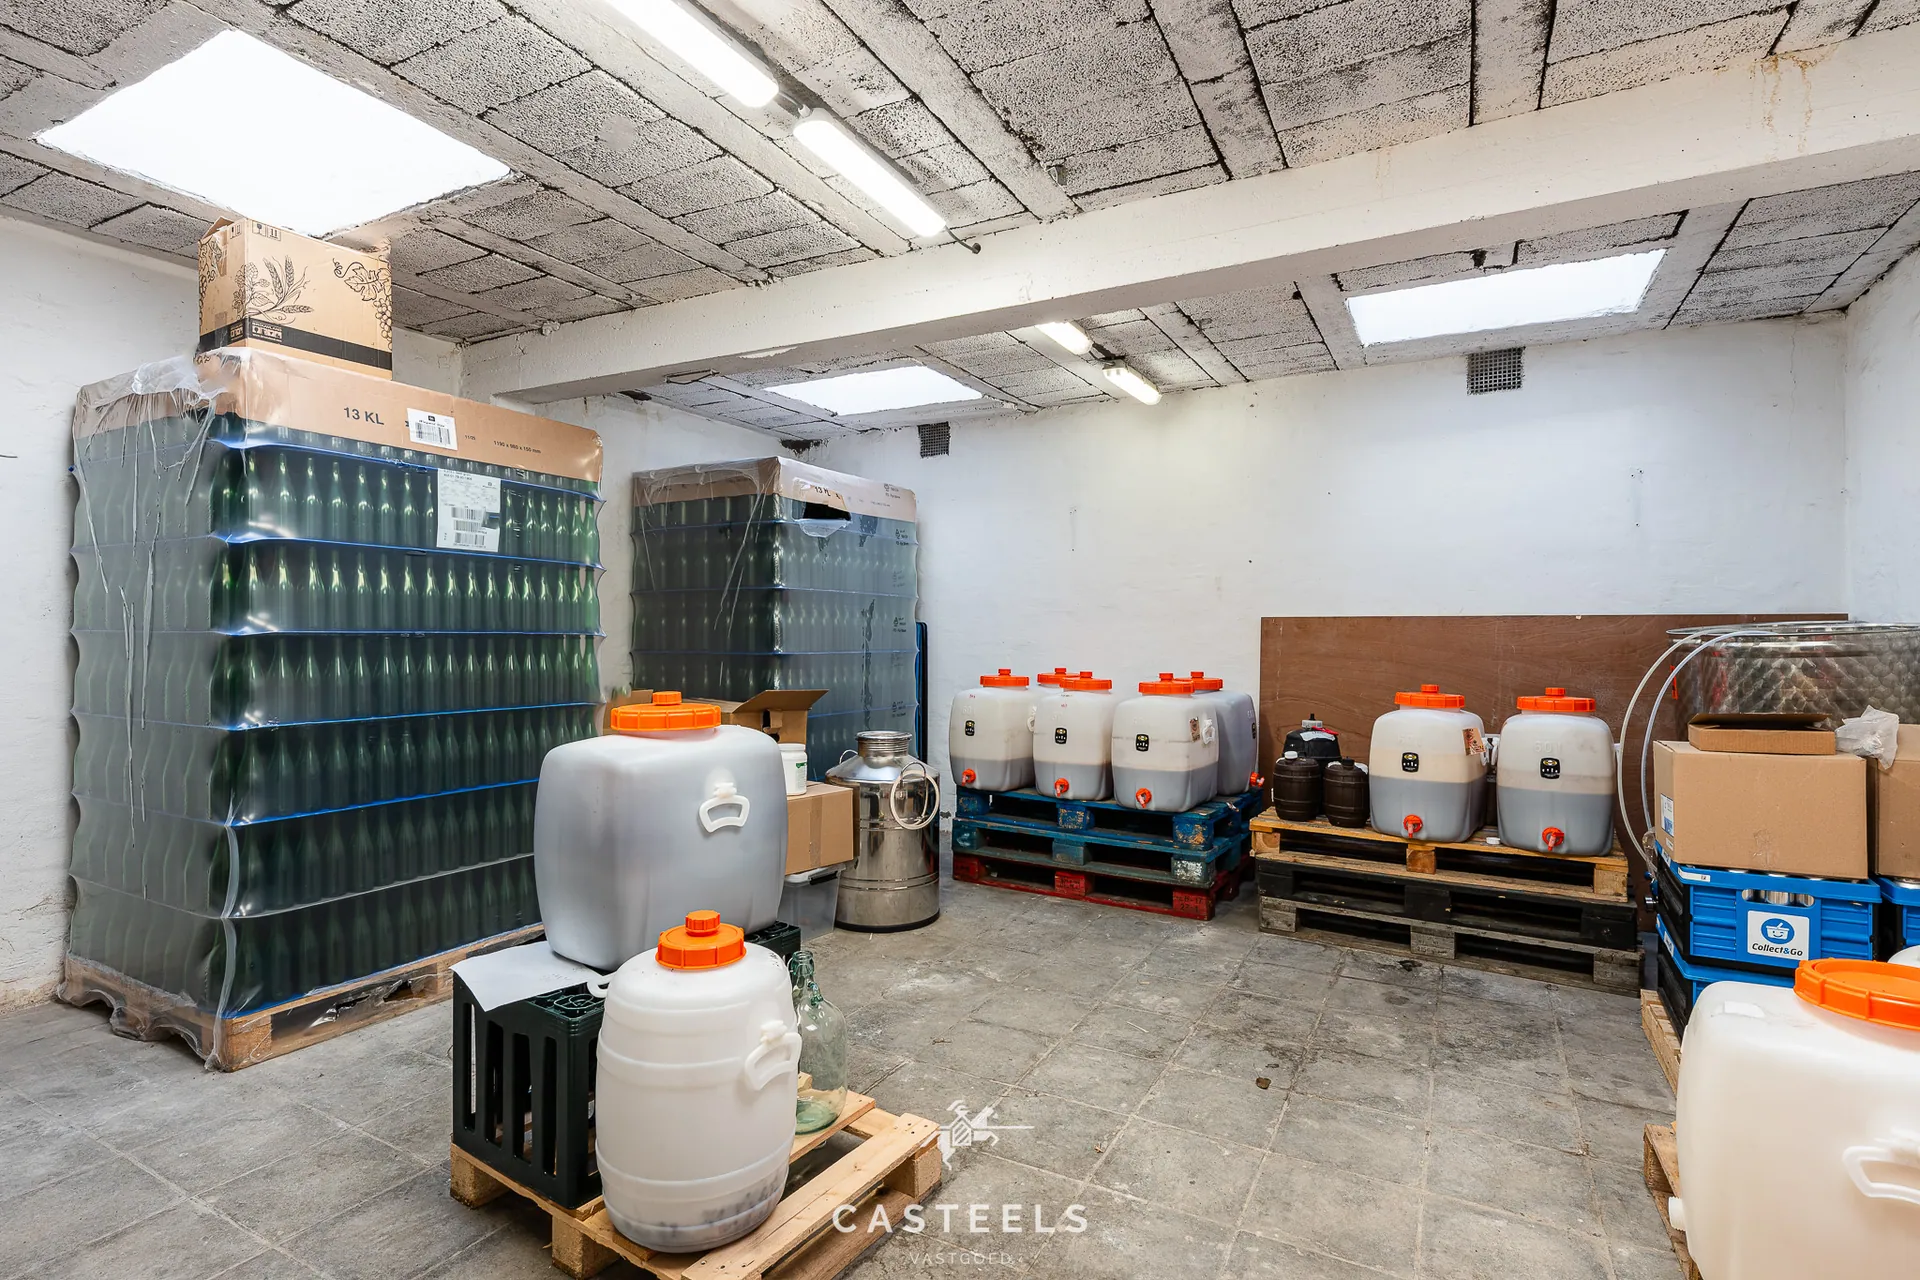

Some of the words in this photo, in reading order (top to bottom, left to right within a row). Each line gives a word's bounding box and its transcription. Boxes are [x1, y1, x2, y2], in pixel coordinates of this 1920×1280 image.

[343, 406, 361, 420] 13
[364, 411, 385, 426] KL
[1752, 942, 1803, 956] Collect&Go
